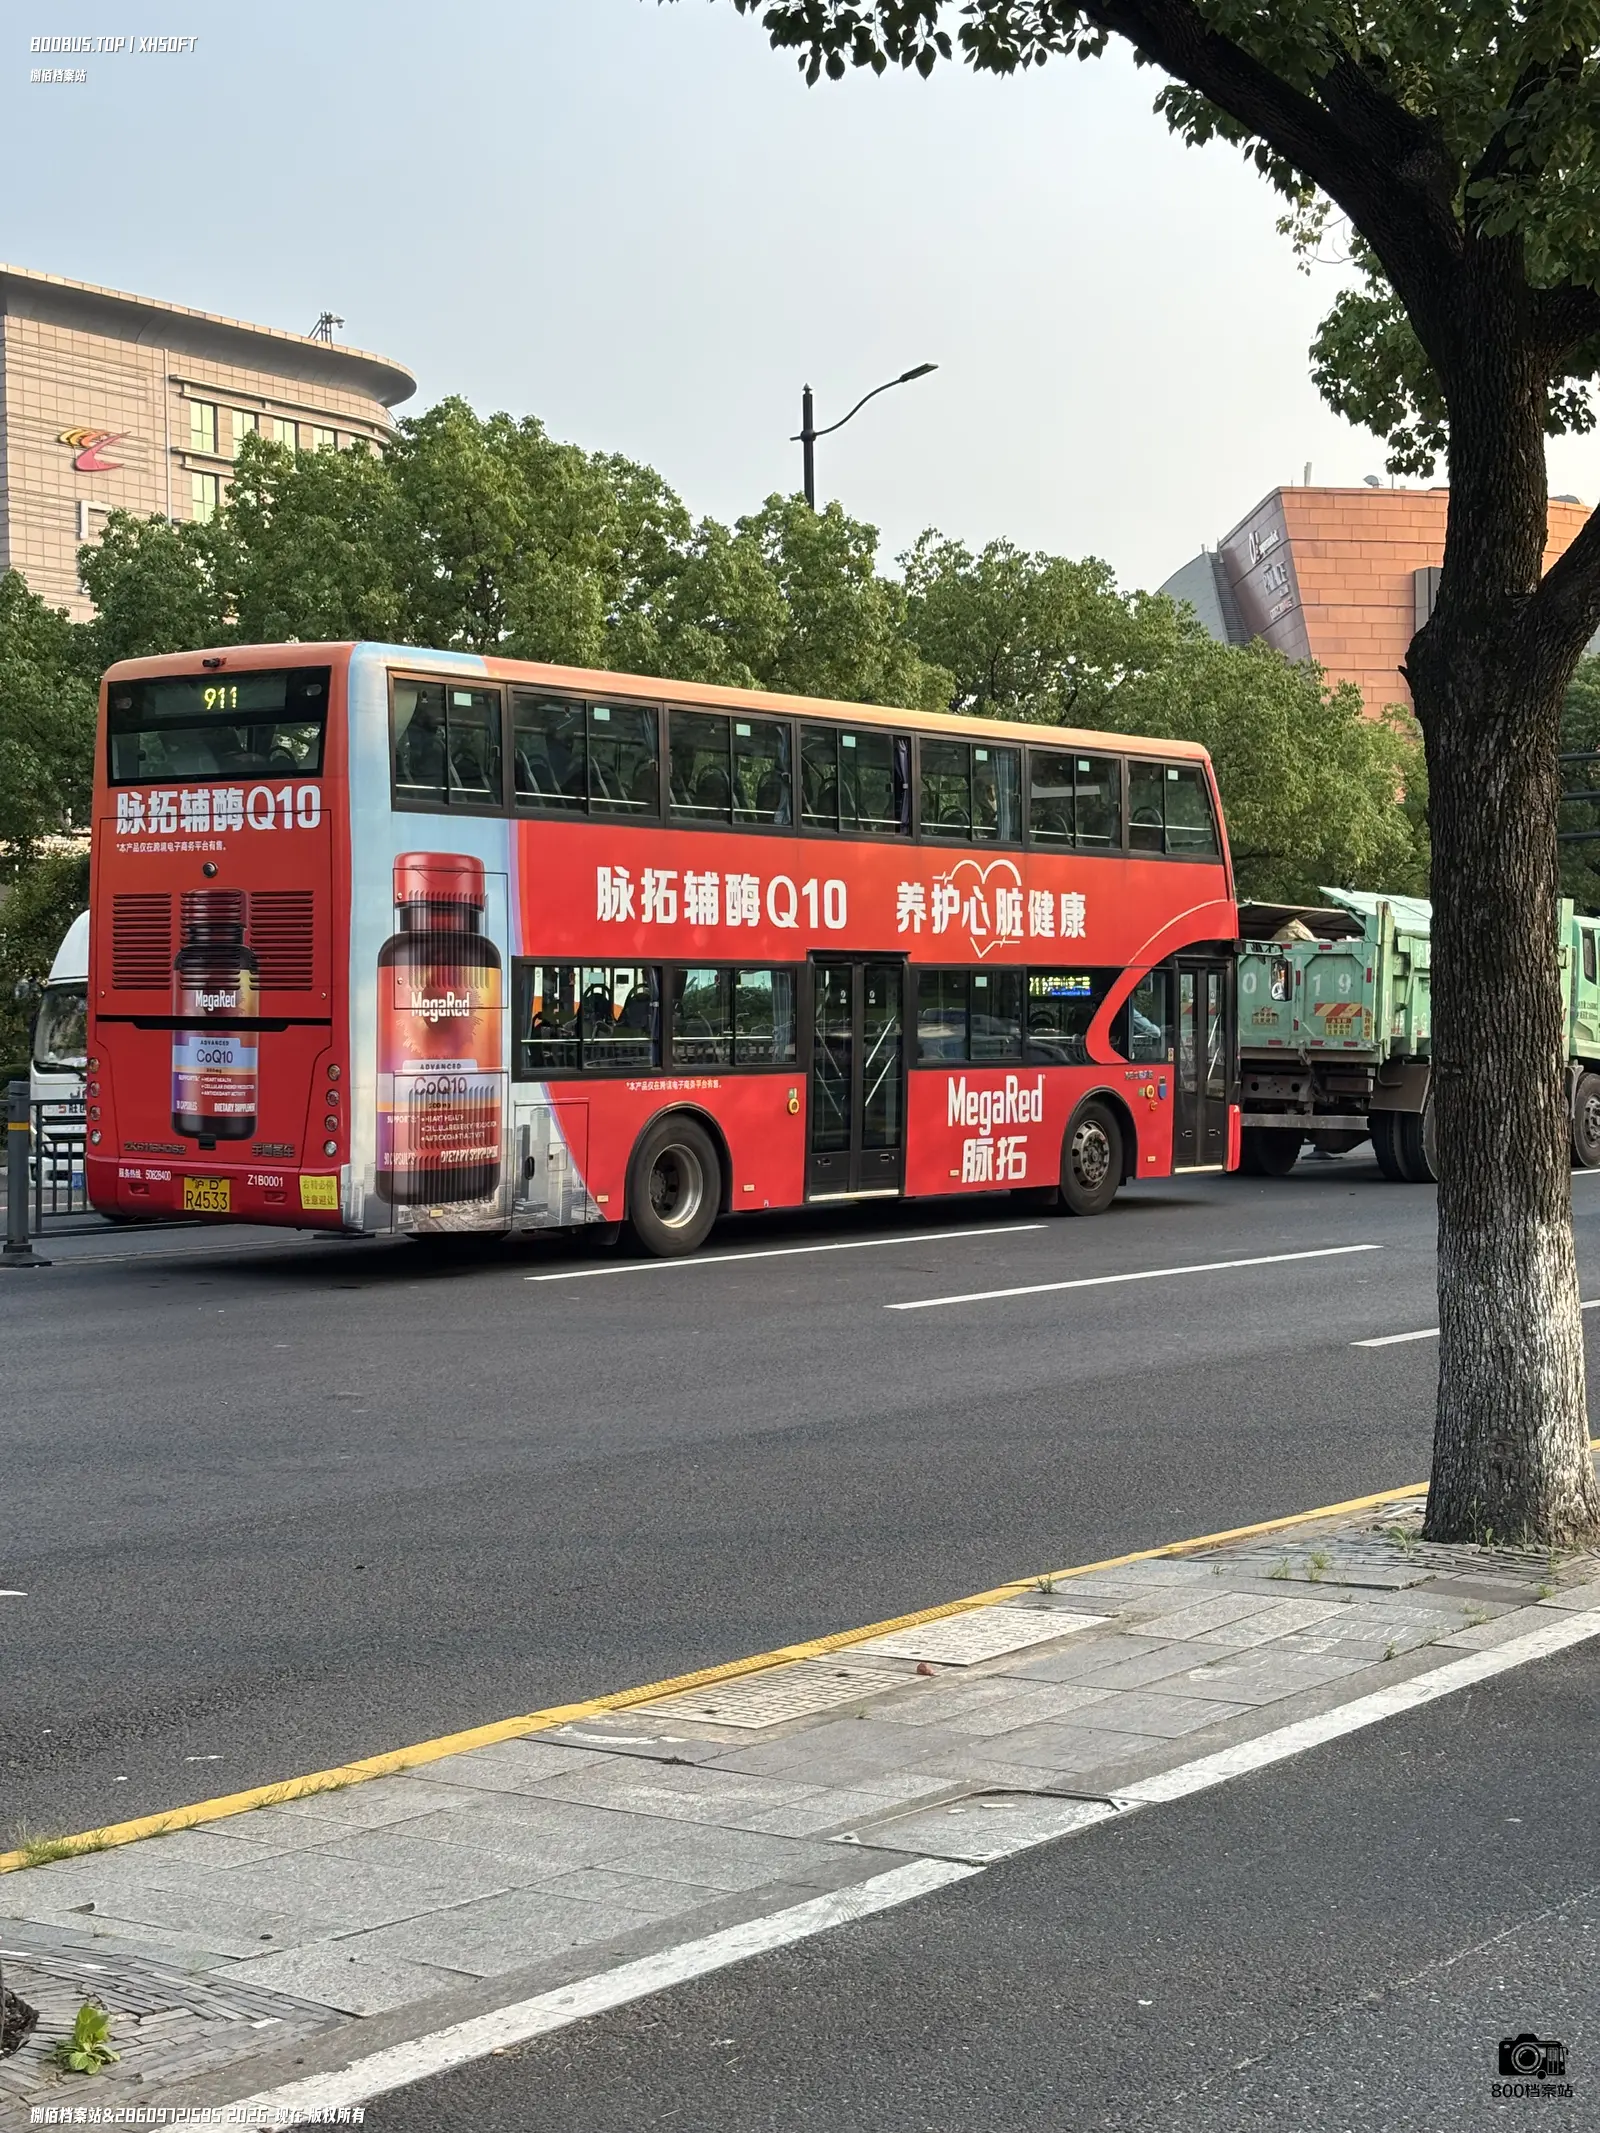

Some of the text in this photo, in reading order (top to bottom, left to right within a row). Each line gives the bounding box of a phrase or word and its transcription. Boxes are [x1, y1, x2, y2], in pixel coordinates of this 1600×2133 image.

[204, 686, 237, 710] 911
[116, 785, 321, 835] 脉拓辅酶Q10
[596, 865, 848, 931] 脉拓辅酶Q10
[895, 880, 1087, 939] 养护心脏健康
[195, 989, 236, 1012] MegaRed
[410, 991, 470, 1023] MegaRed
[196, 1048, 234, 1064] CoQ10
[413, 1076, 467, 1096] CoQ10
[947, 1074, 1043, 1136] MegaRed
[961, 1136, 1027, 1183] 脉拓
[247, 1174, 284, 1187] Z1B0001
[185, 1190, 229, 1210] R4533
